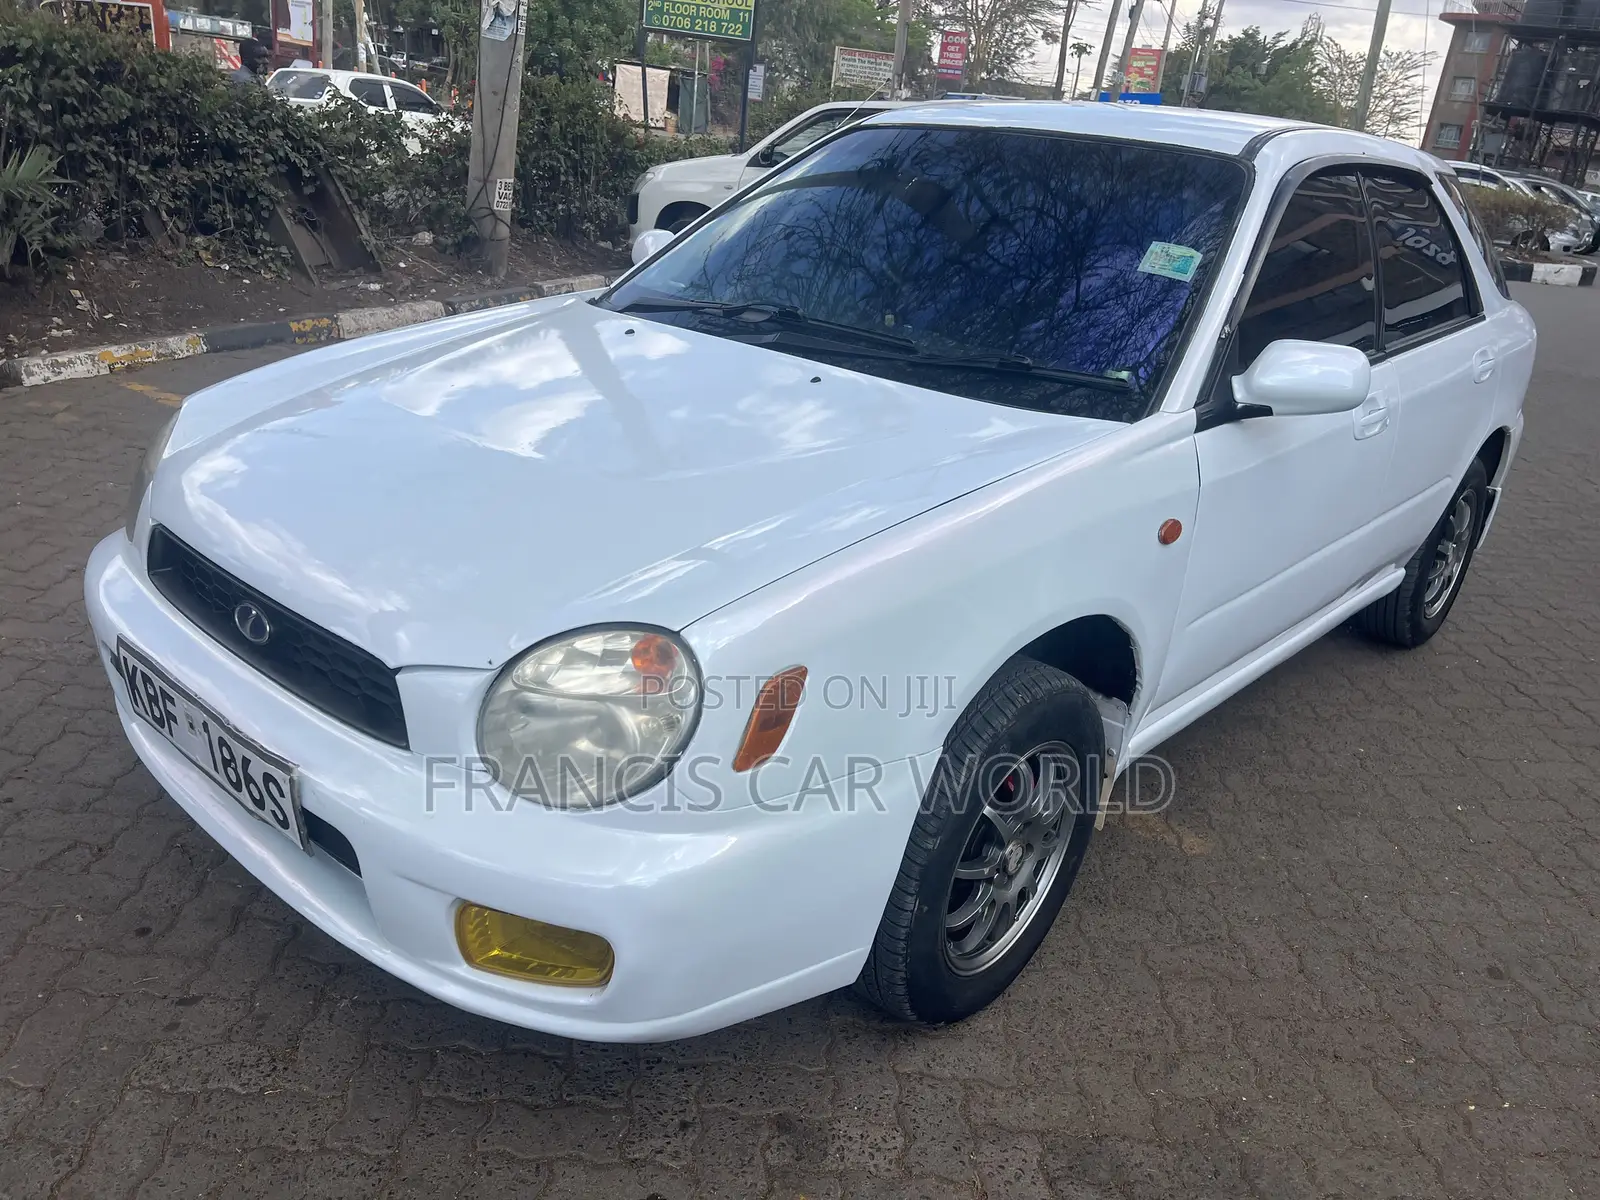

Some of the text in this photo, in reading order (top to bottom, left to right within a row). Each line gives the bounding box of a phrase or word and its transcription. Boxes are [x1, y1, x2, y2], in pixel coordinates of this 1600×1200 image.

[663, 2, 697, 16] FLOOR
[699, 6, 730, 20] ROOM
[739, 12, 749, 23] 11
[662, 15, 742, 35] 0706 218 722
[943, 34, 968, 44] LOOK
[498, 181, 513, 190] 3 BE
[122, 655, 290, 831] KBF 186S
